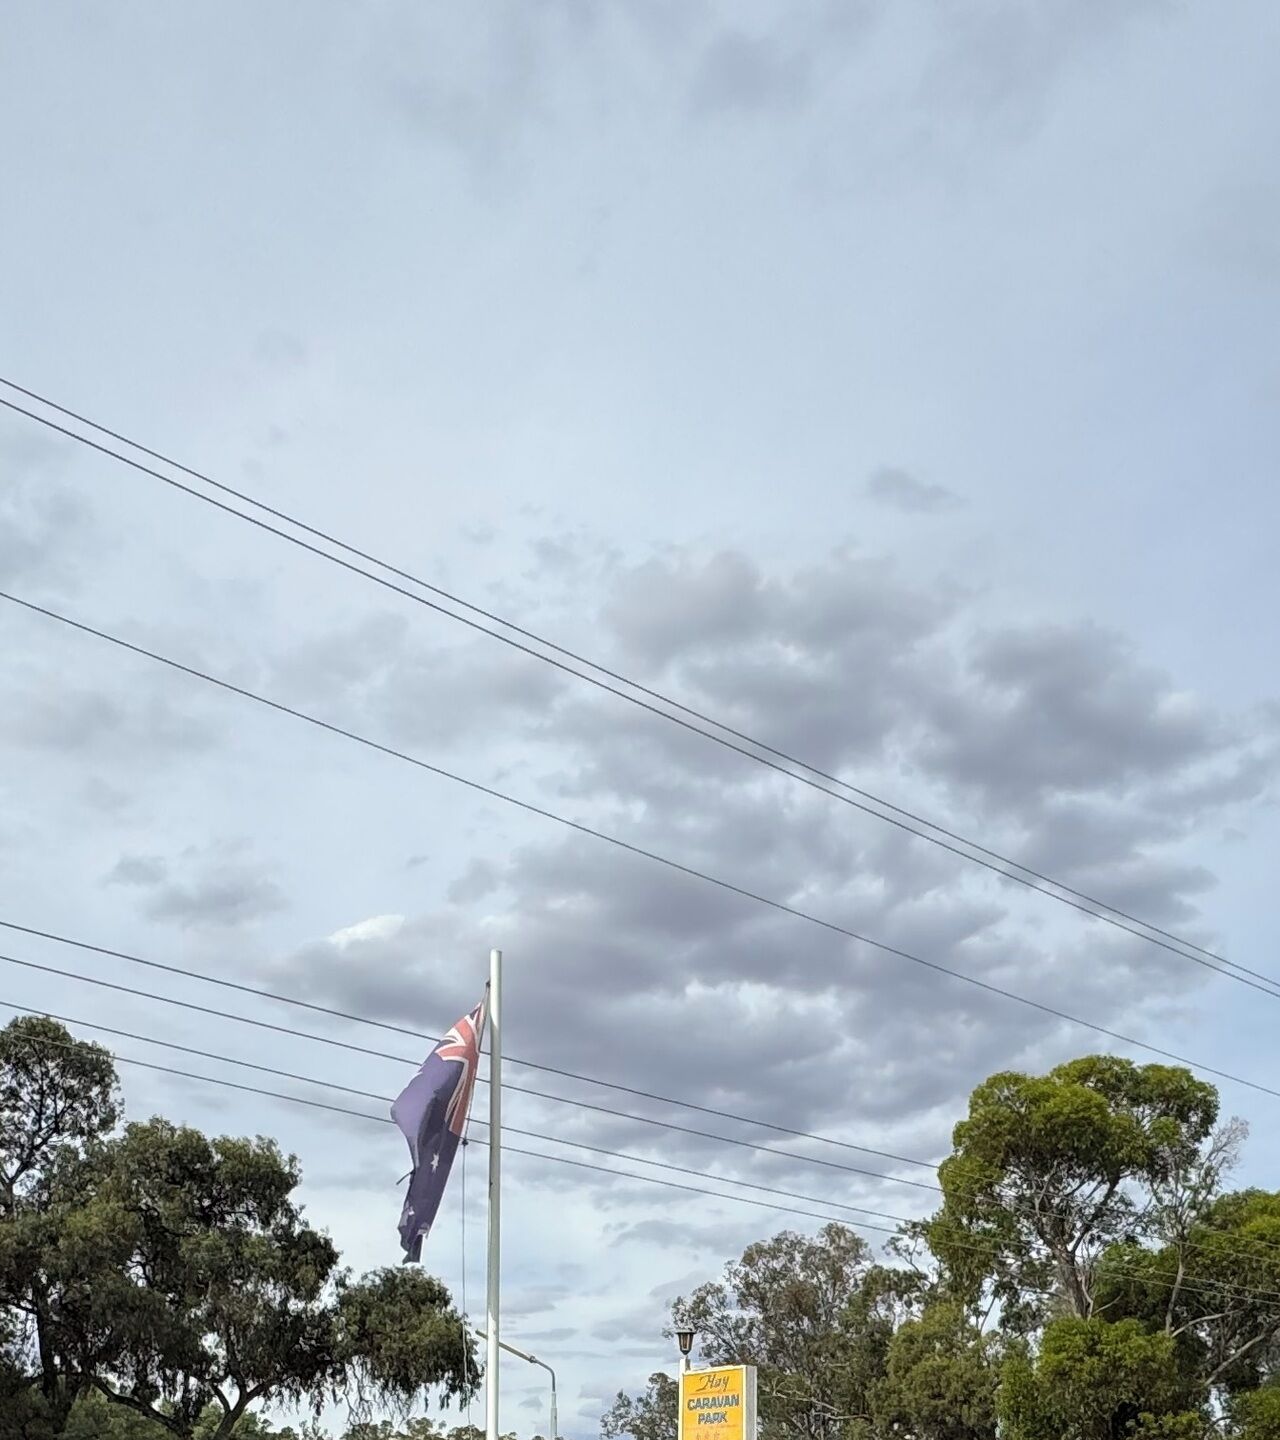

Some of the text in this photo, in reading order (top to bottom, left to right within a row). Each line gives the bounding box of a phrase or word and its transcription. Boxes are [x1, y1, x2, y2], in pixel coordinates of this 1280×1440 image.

[695, 1373, 730, 1392] Hay
[687, 1394, 740, 1410] CARAVAN
[698, 1411, 728, 1424] PARK
